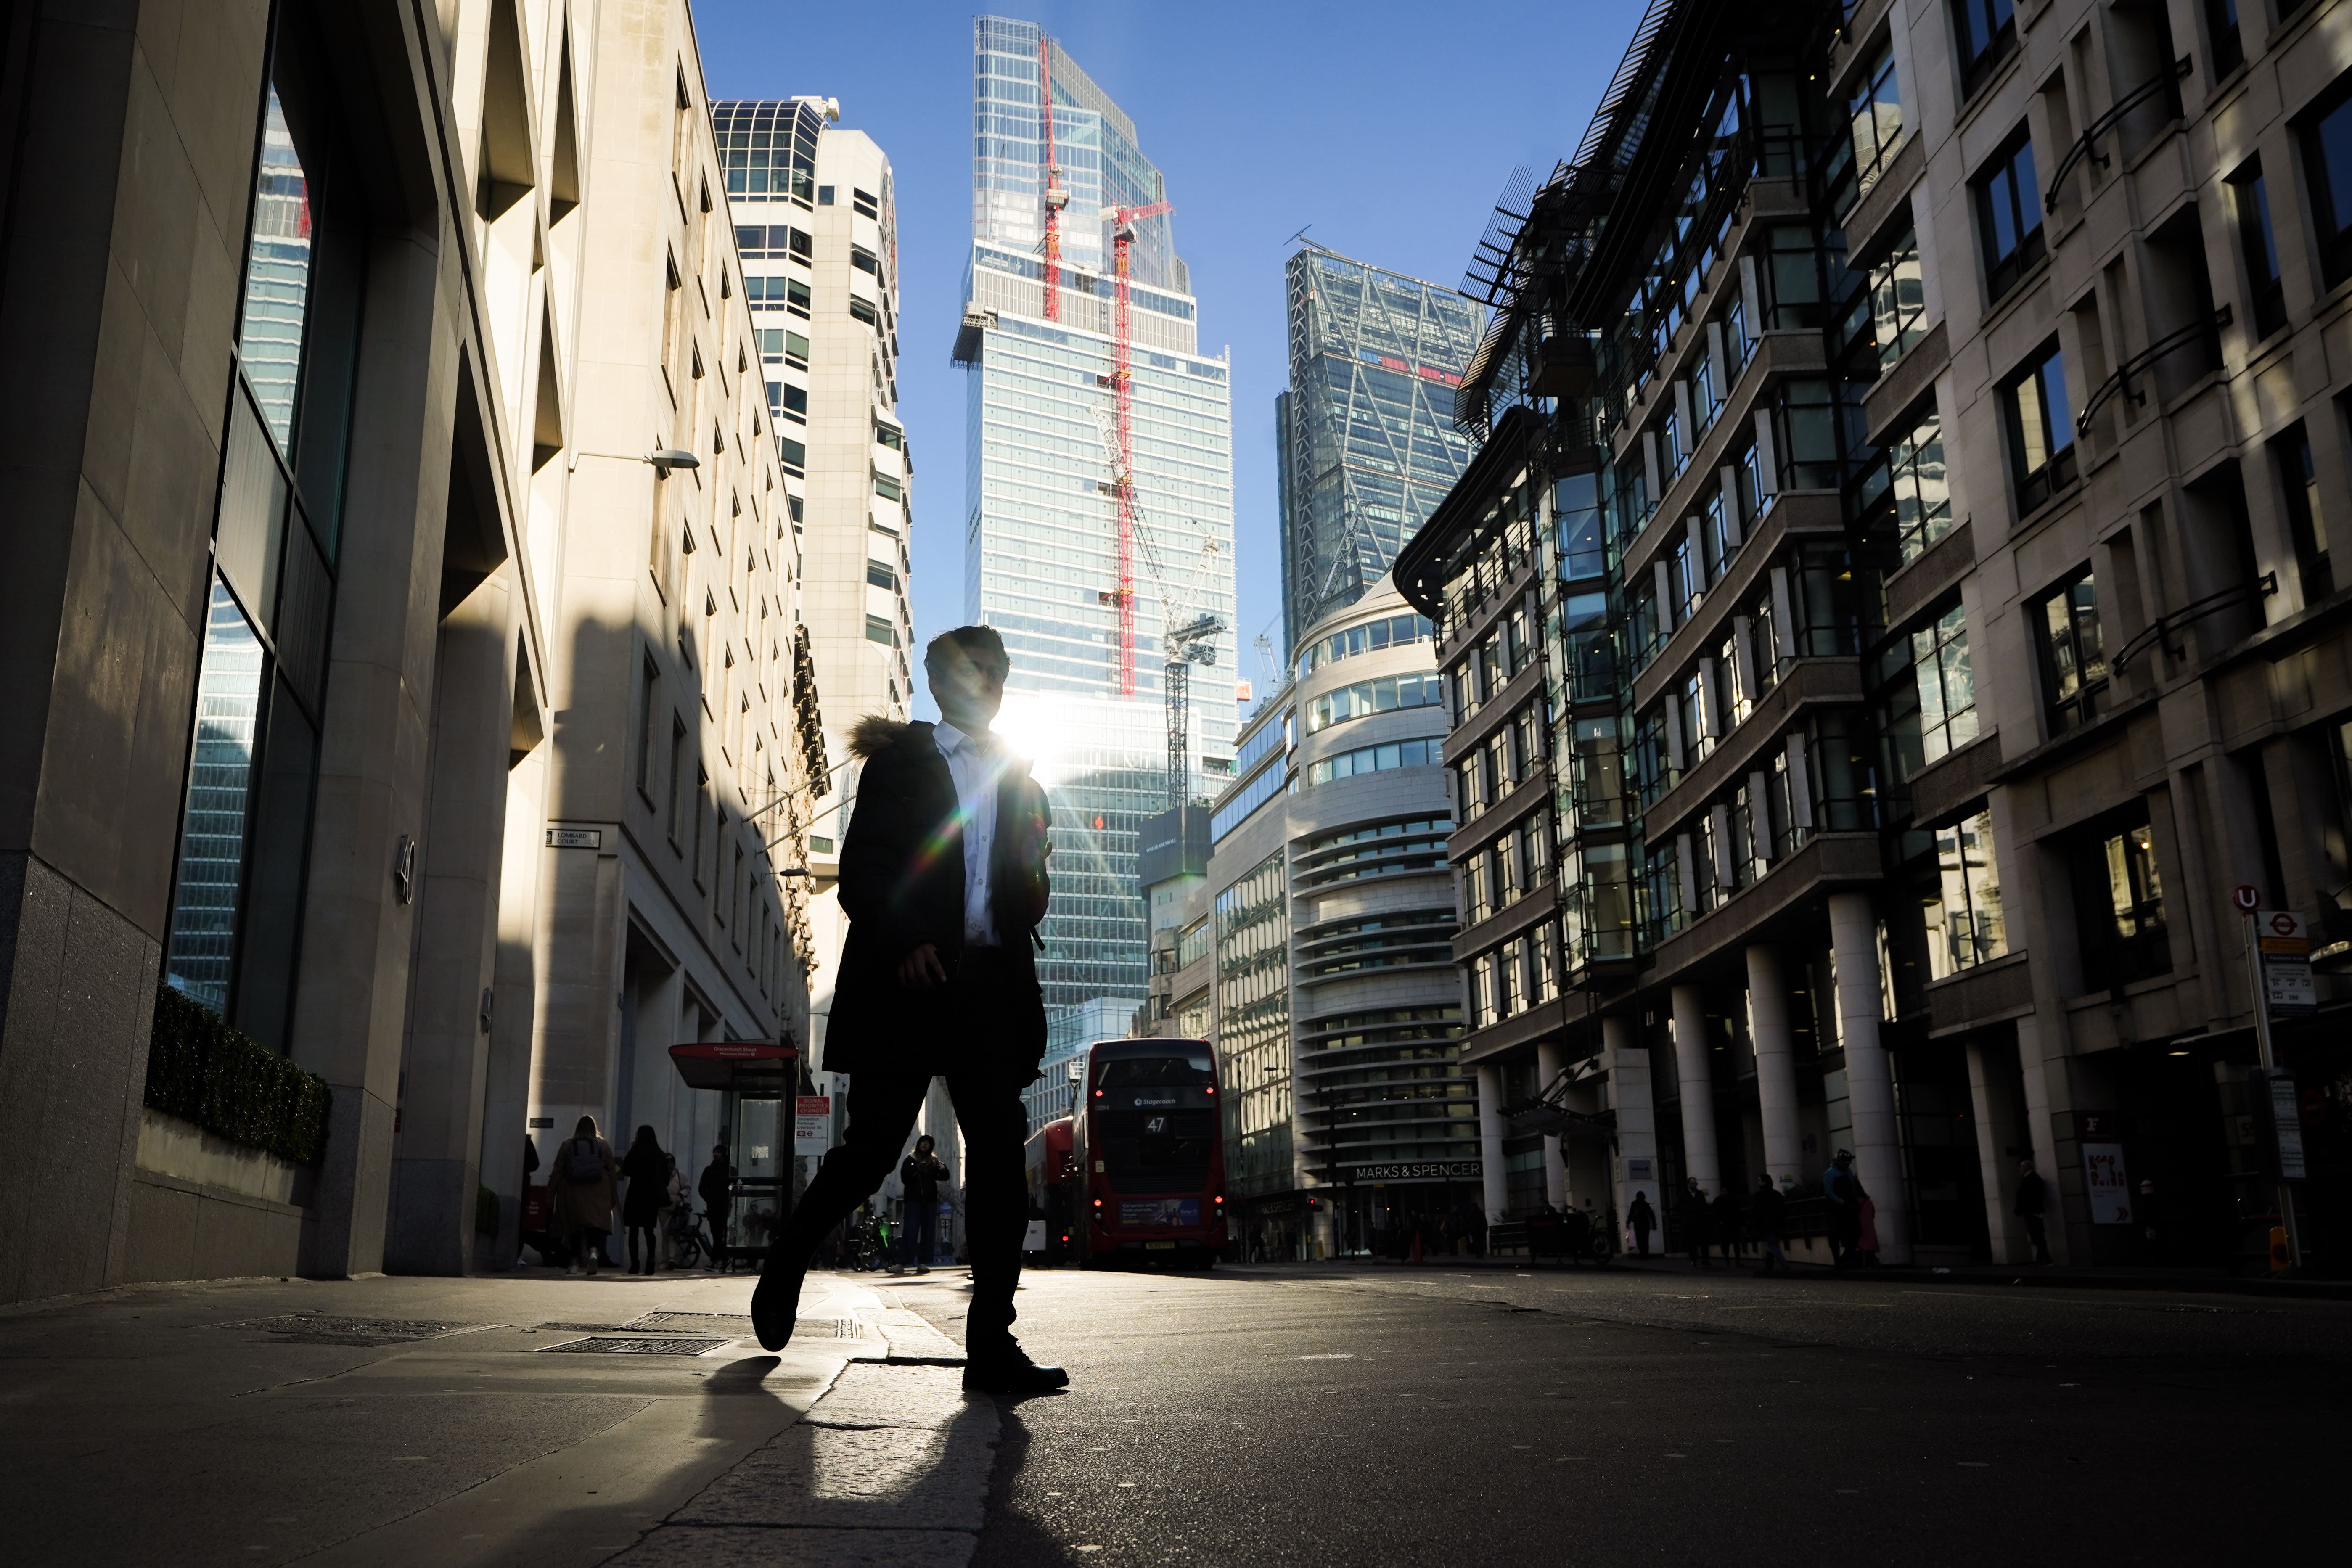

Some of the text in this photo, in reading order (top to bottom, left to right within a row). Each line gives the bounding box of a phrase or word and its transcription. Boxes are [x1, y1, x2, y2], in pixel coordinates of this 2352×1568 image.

[2238, 889, 2256, 907] U
[1147, 1117, 1164, 1132] 47
[1357, 1163, 1480, 1178] MARKS & SPENCER
